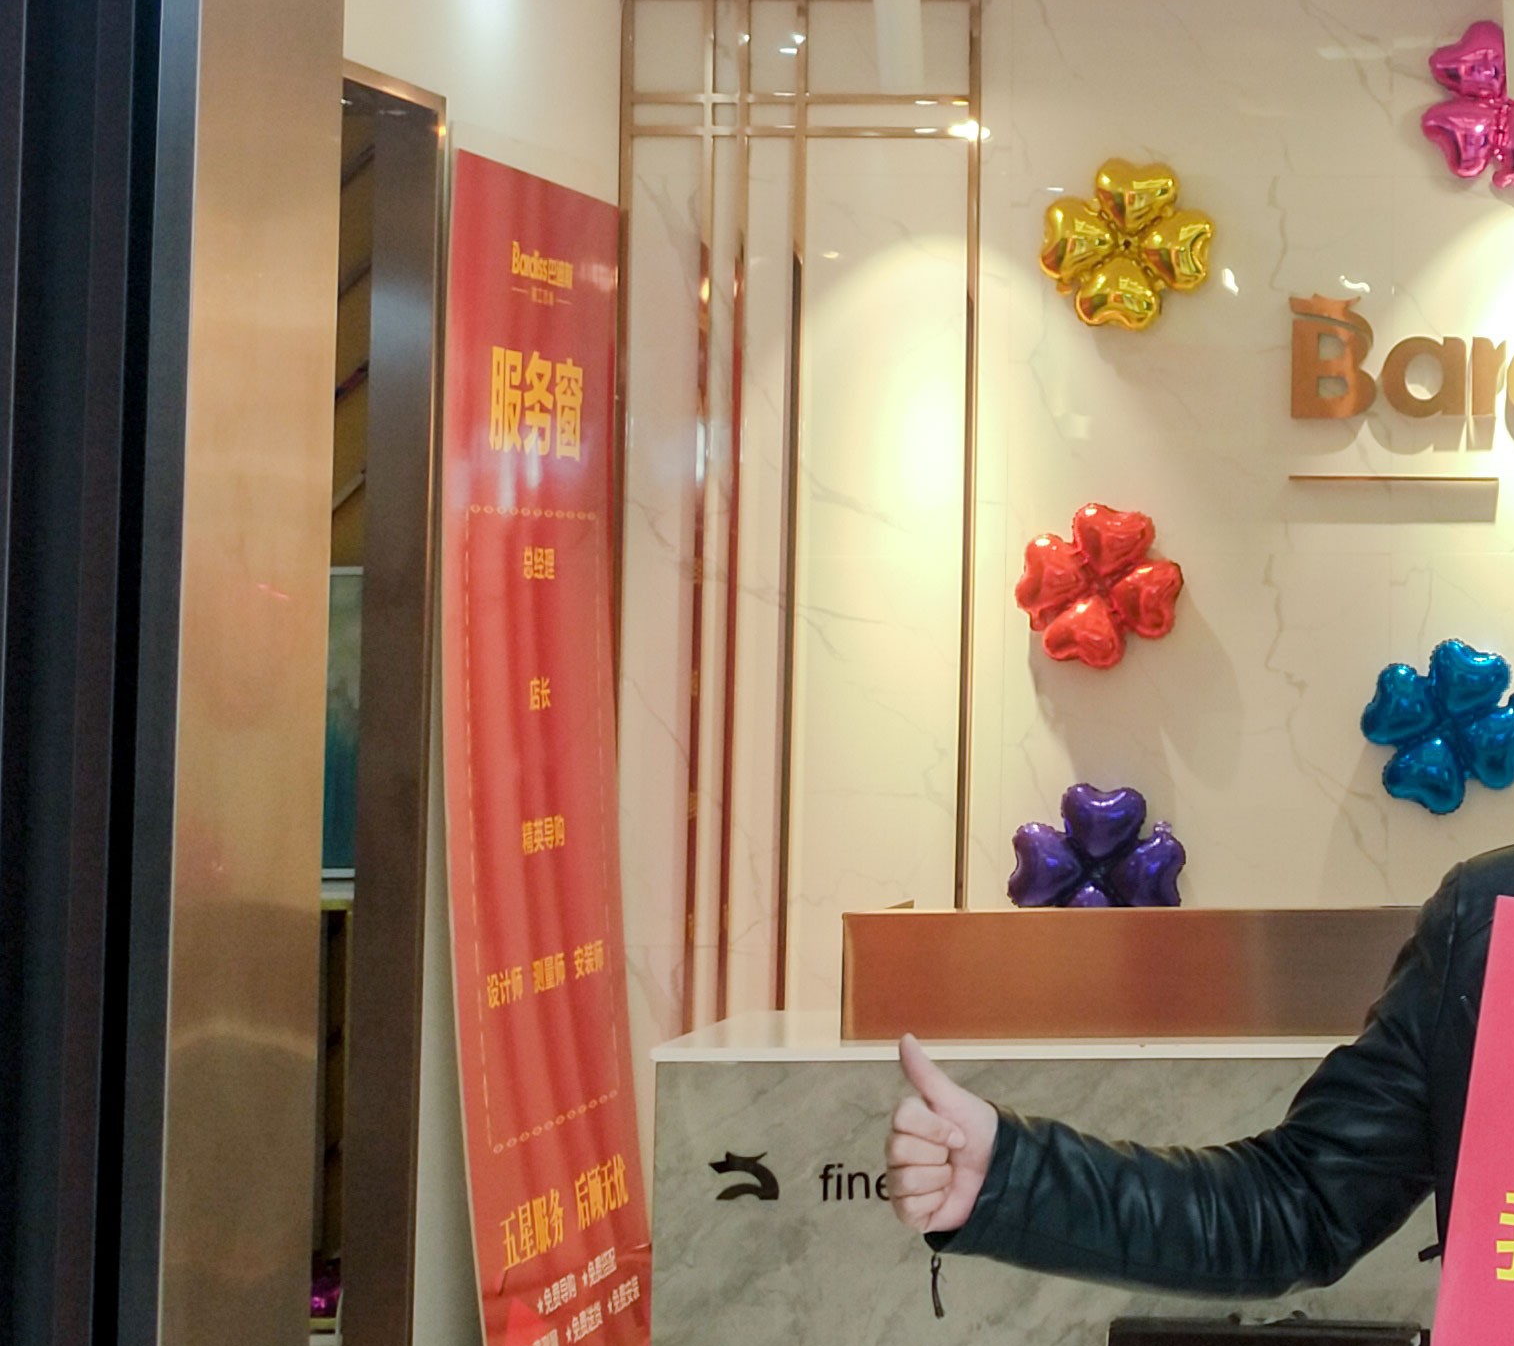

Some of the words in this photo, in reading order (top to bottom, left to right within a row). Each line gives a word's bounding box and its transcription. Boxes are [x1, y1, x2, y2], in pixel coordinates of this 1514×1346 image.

[489, 346, 583, 461] 服务窗
[523, 547, 555, 579] 总经理
[529, 677, 551, 710] 店长
[522, 815, 565, 854] 精英导购
[487, 966, 523, 1008] 设计师
[532, 953, 566, 993] 测量师
[574, 940, 604, 979] 安装师
[500, 1188, 564, 1272] 五星服务
[575, 1154, 629, 1230] 后顾无忧
